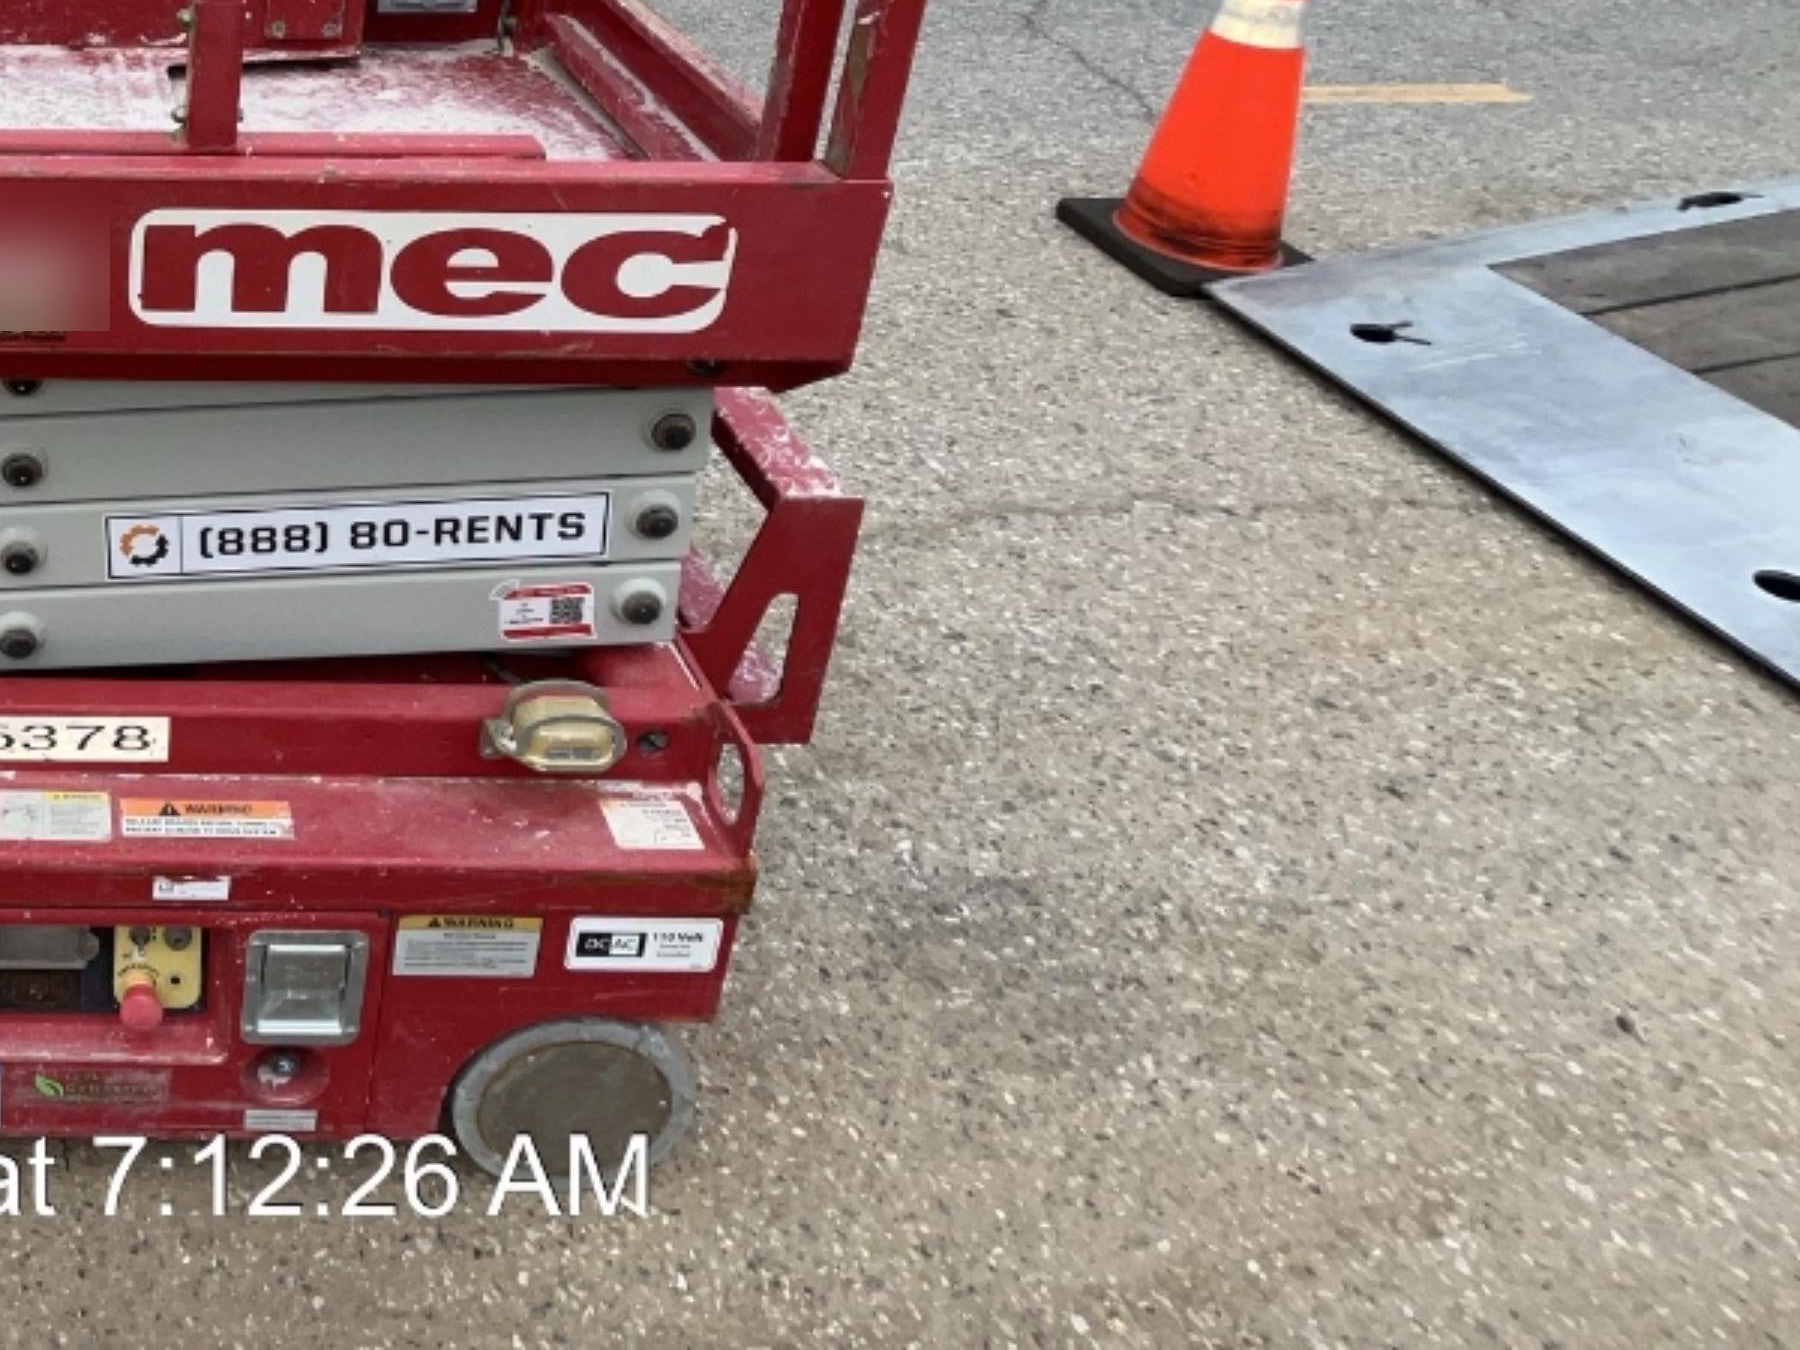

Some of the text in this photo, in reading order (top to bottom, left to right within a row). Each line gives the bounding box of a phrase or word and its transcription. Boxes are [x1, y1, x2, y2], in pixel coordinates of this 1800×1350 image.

[140, 222, 728, 319] mec
[199, 511, 586, 559] (888) 80-RENTS
[443, 917, 514, 929] WARNING
